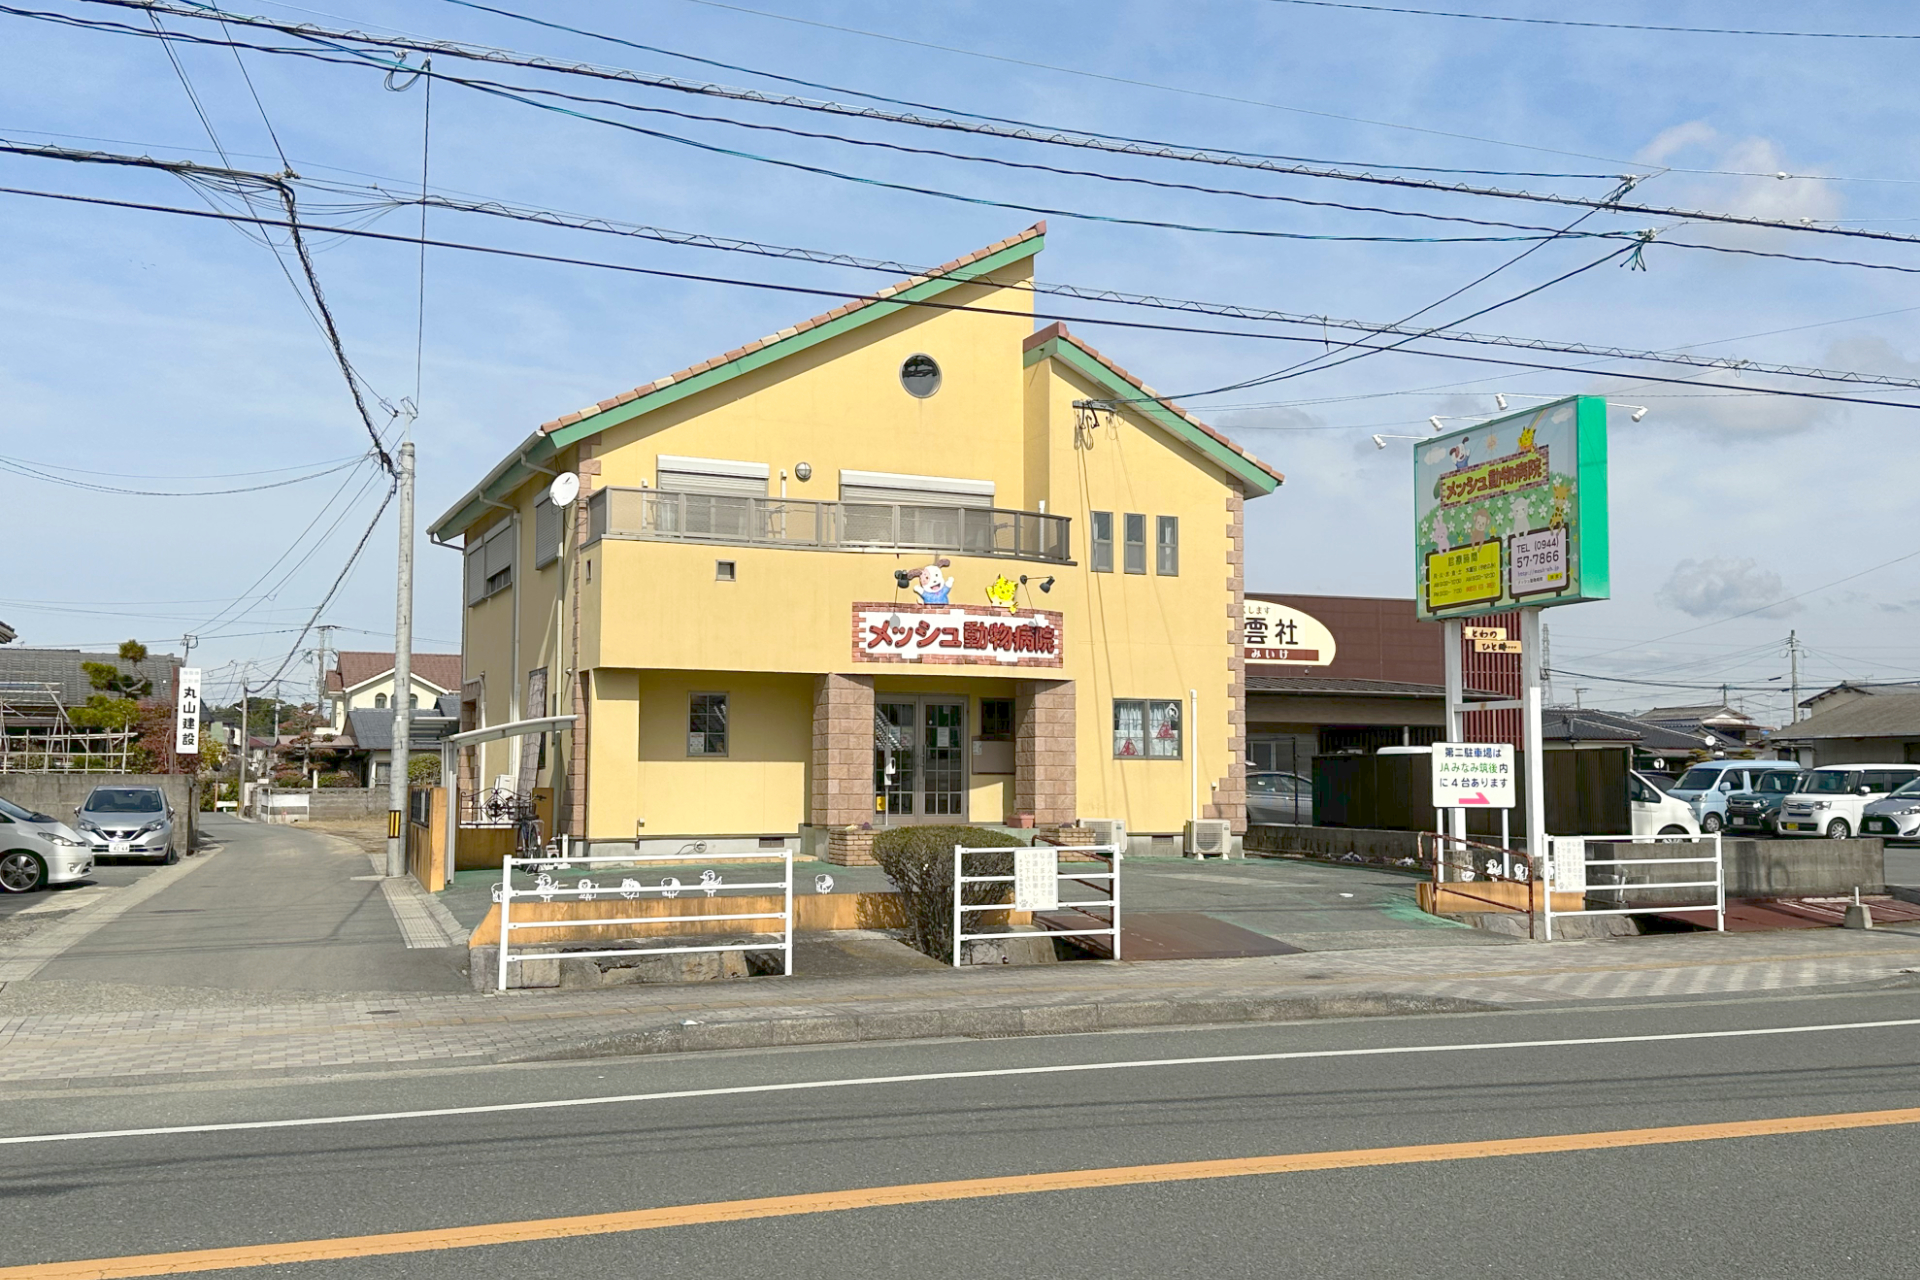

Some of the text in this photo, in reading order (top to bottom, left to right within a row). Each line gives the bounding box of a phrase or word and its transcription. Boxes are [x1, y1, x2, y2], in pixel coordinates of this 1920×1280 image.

[1446, 458, 1542, 500] メッシュ動物病院
[1516, 535, 1559, 553] TEL (0944)
[1516, 550, 1559, 568] 57-7866
[867, 619, 1056, 655] メッシュ動物病院
[1244, 617, 1298, 645] 雲社
[1472, 630, 1497, 639] とわの
[1251, 649, 1289, 659] みいけ
[182, 686, 197, 746] 丸山建設
[1445, 747, 1502, 758] 第二駐車場は
[1440, 778, 1508, 788] に4台あります
